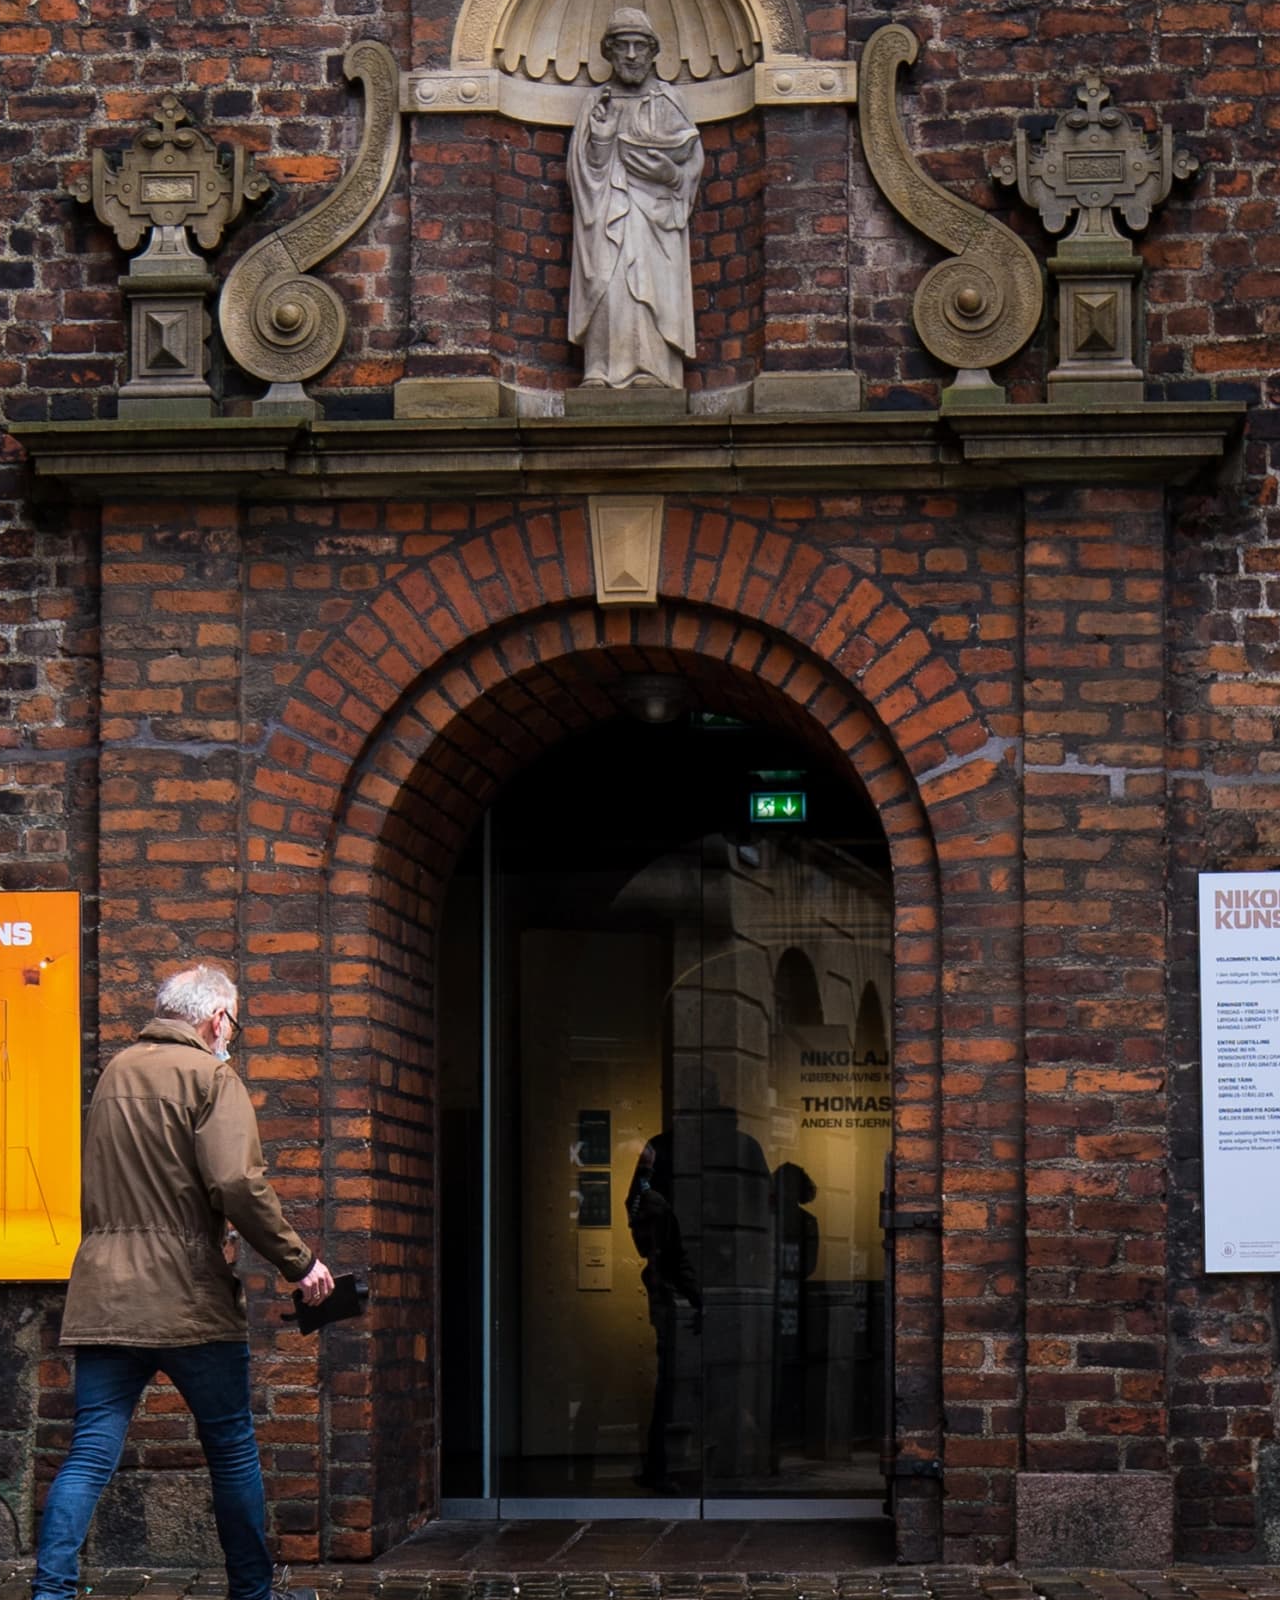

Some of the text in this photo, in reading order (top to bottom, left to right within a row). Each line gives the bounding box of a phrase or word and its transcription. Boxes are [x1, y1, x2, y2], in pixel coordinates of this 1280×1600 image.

[800, 1050, 889, 1066] NIKOLAJ
[800, 1072, 881, 1082] KØBENHAVNS
[801, 1096, 892, 1112] THOMAS
[801, 1118, 842, 1128] ANDEN
